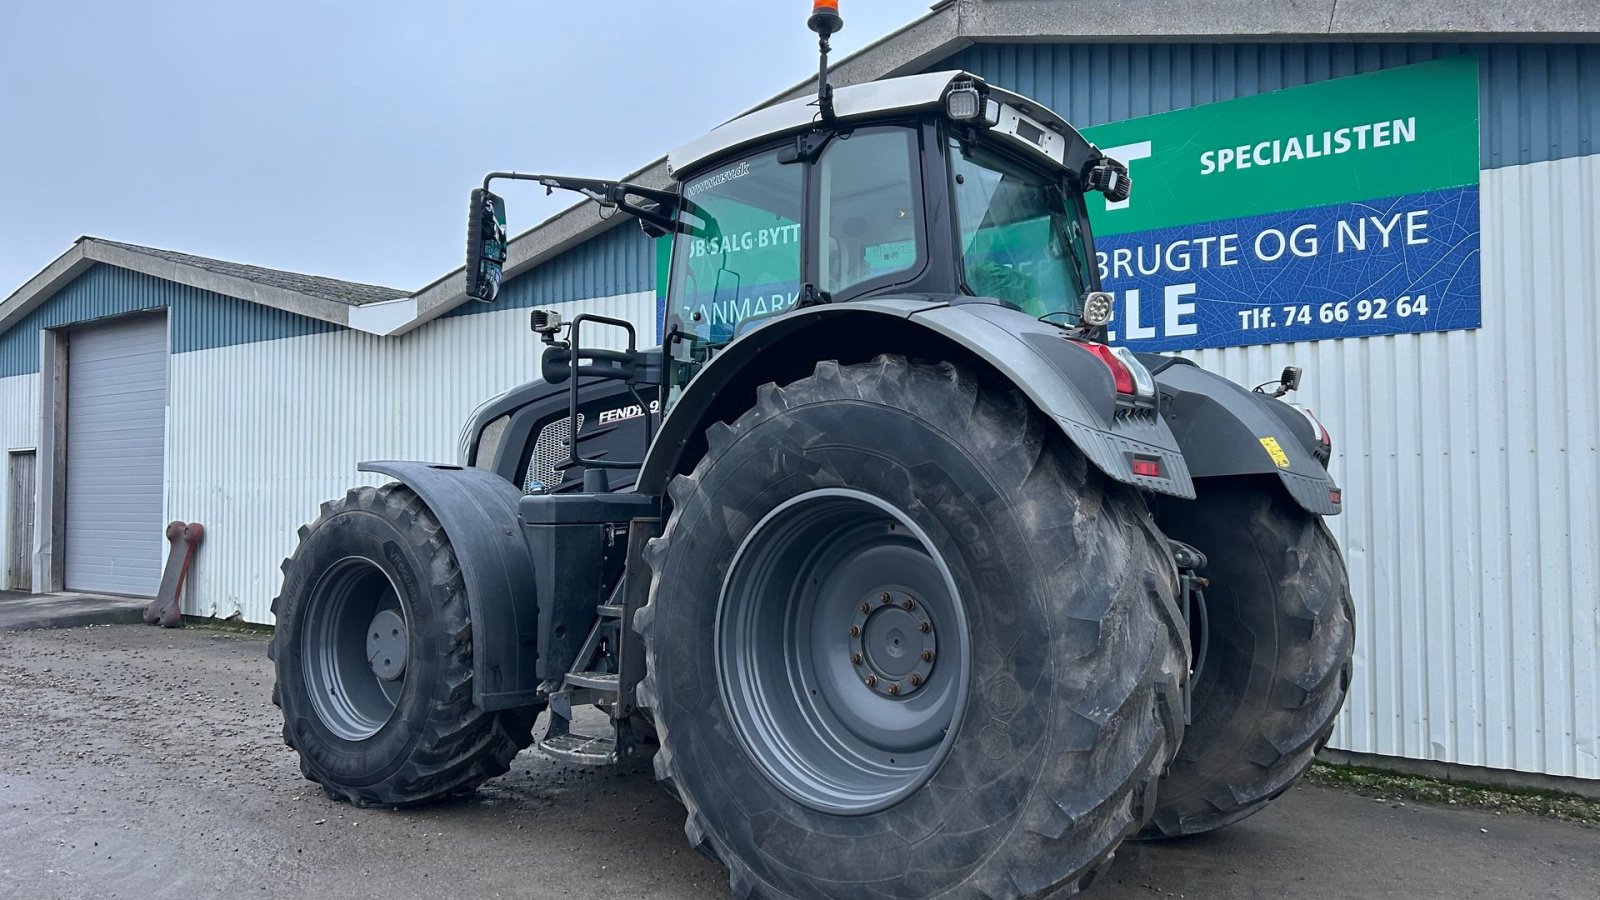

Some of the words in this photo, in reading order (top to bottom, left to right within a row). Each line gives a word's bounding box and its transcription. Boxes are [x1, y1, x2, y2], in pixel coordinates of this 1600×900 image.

[1200, 117, 1417, 175] SPECIALISTEN
[1096, 234, 1238, 280] BRUGTE
[1254, 224, 1318, 262] OG
[1337, 210, 1429, 253] NYE
[1238, 307, 1276, 330] Tlf.
[1283, 304, 1312, 327] 74
[1319, 301, 1349, 324] 66
[1356, 298, 1388, 321] 92
[1396, 294, 1429, 317] 64
